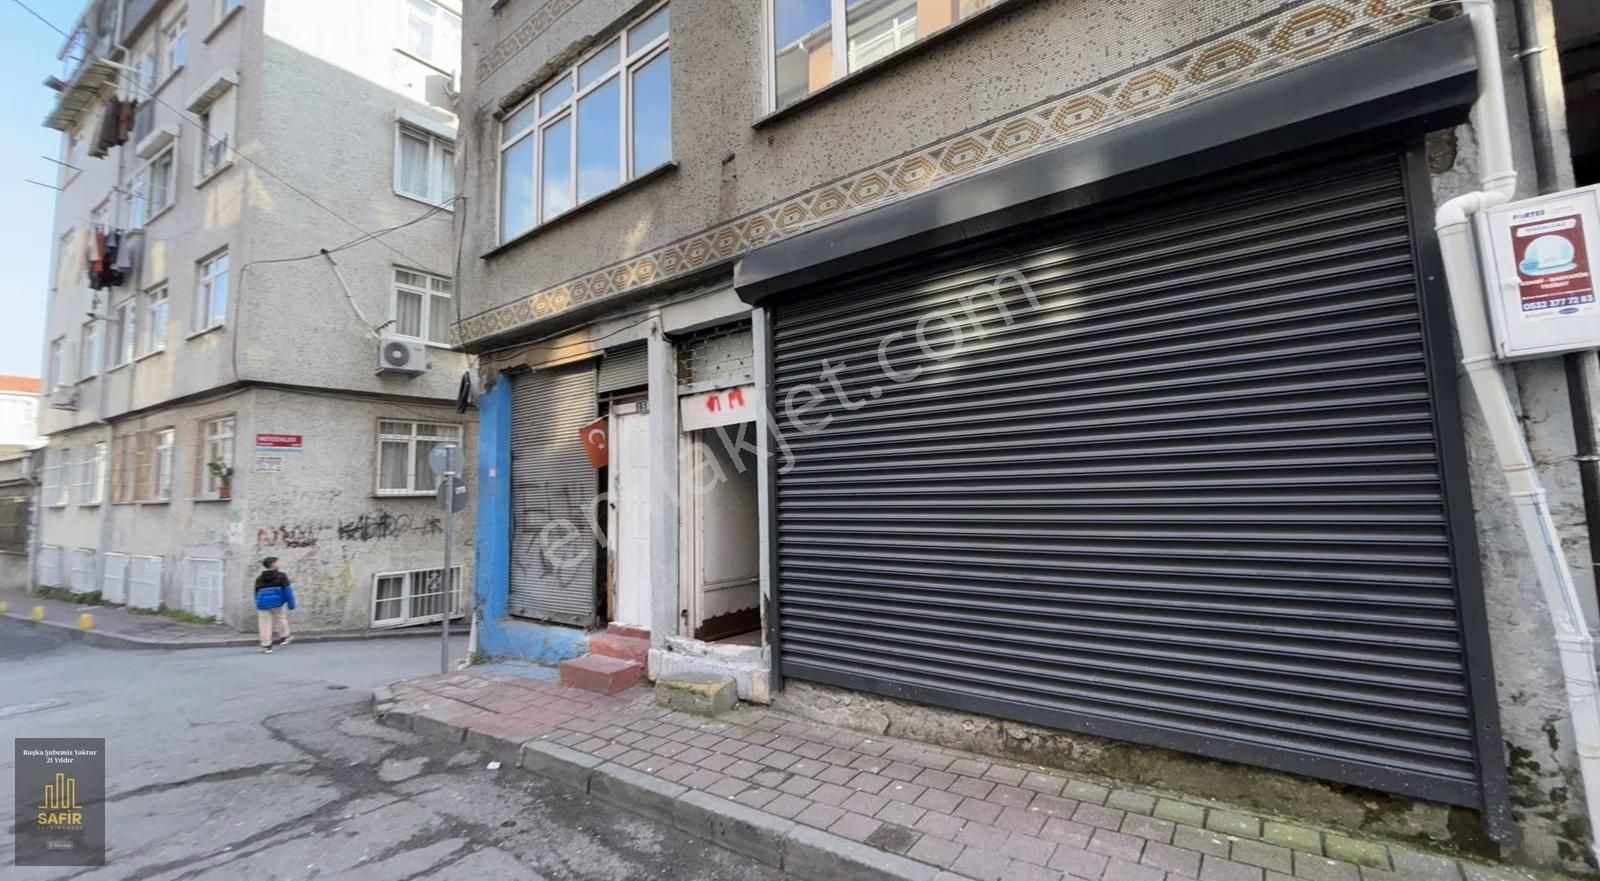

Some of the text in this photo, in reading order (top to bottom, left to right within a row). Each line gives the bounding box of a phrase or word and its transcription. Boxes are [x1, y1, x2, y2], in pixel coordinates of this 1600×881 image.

[1523, 300, 1547, 311] 0532
[1549, 297, 1566, 307] 377
[1567, 296, 1579, 304] 72
